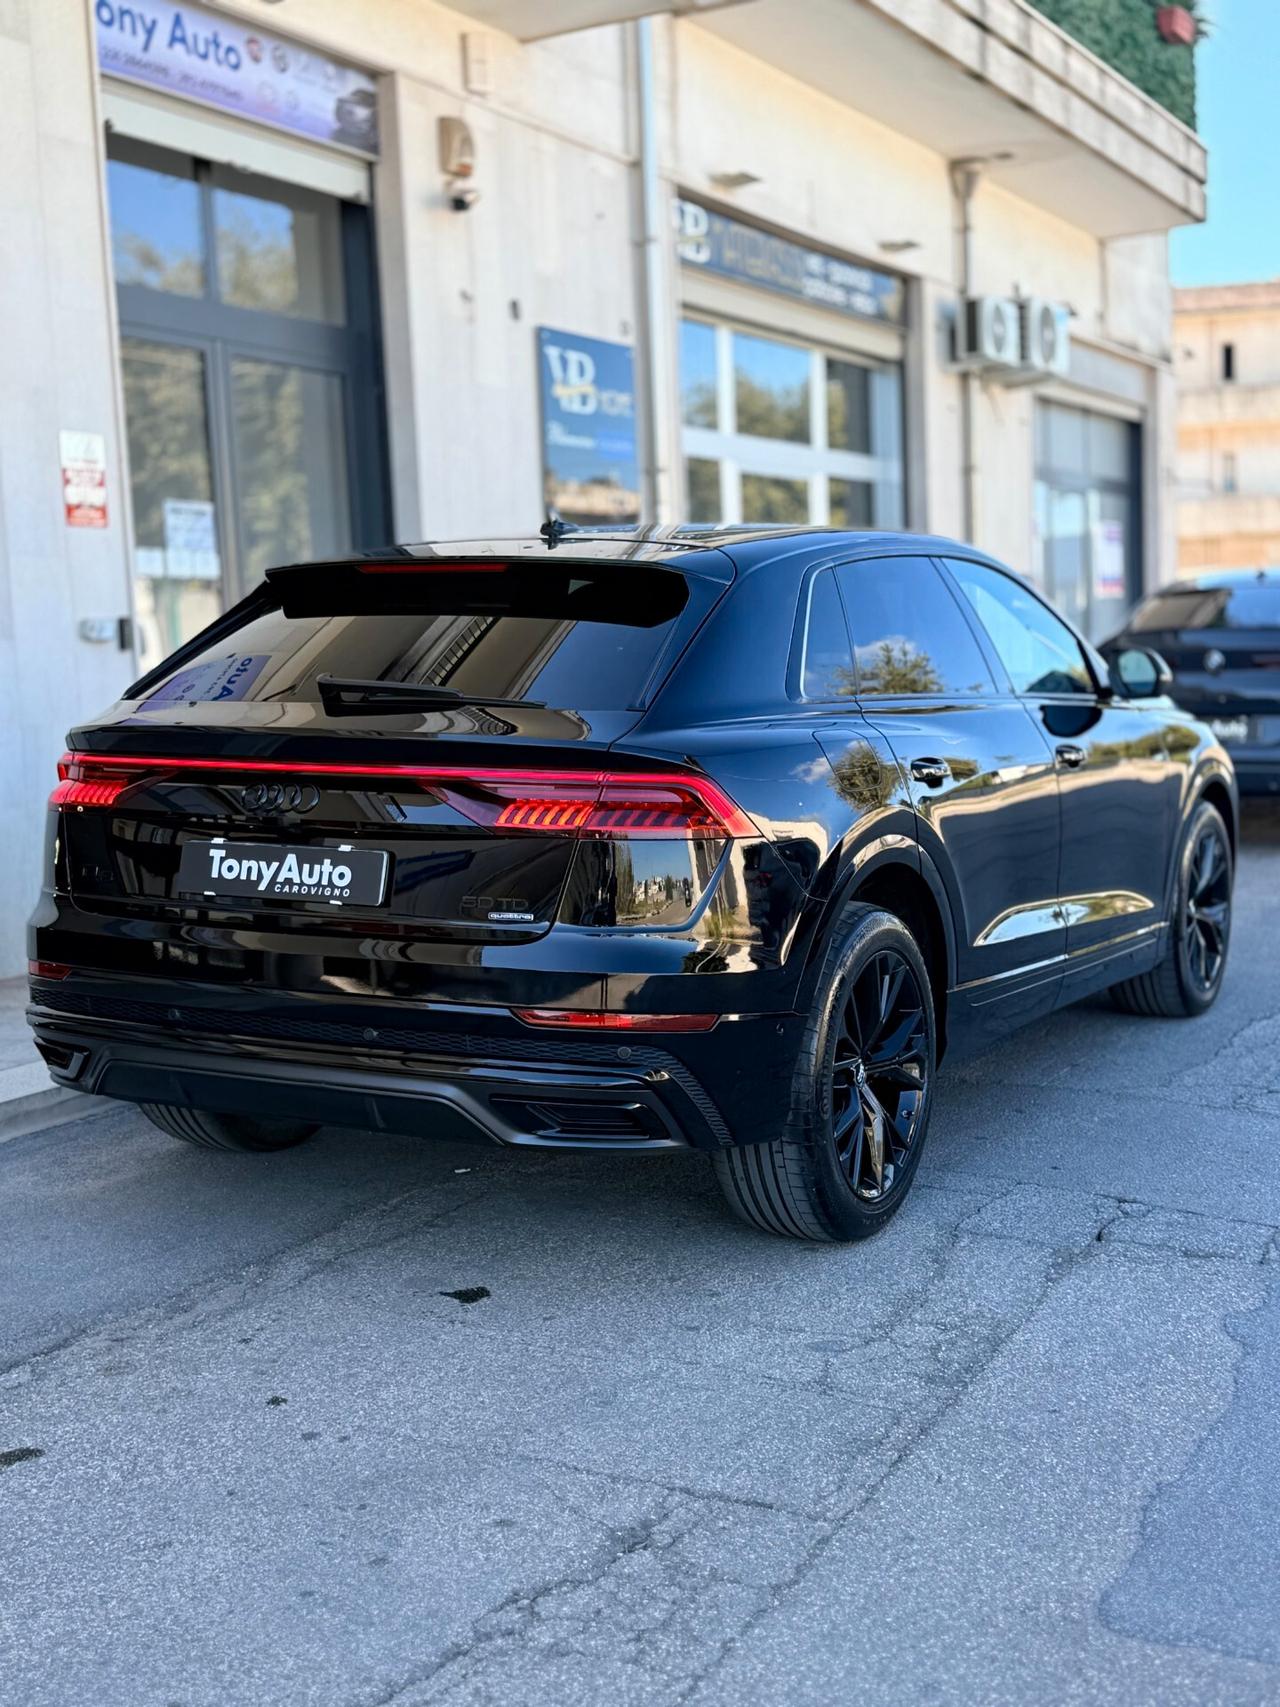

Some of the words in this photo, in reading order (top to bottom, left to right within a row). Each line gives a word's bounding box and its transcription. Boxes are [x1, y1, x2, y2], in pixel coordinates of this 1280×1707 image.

[95, 0, 157, 51] ony
[167, 12, 242, 72] Auto
[274, 884, 351, 898] CAROVIGNO
[488, 912, 534, 921] quattro
